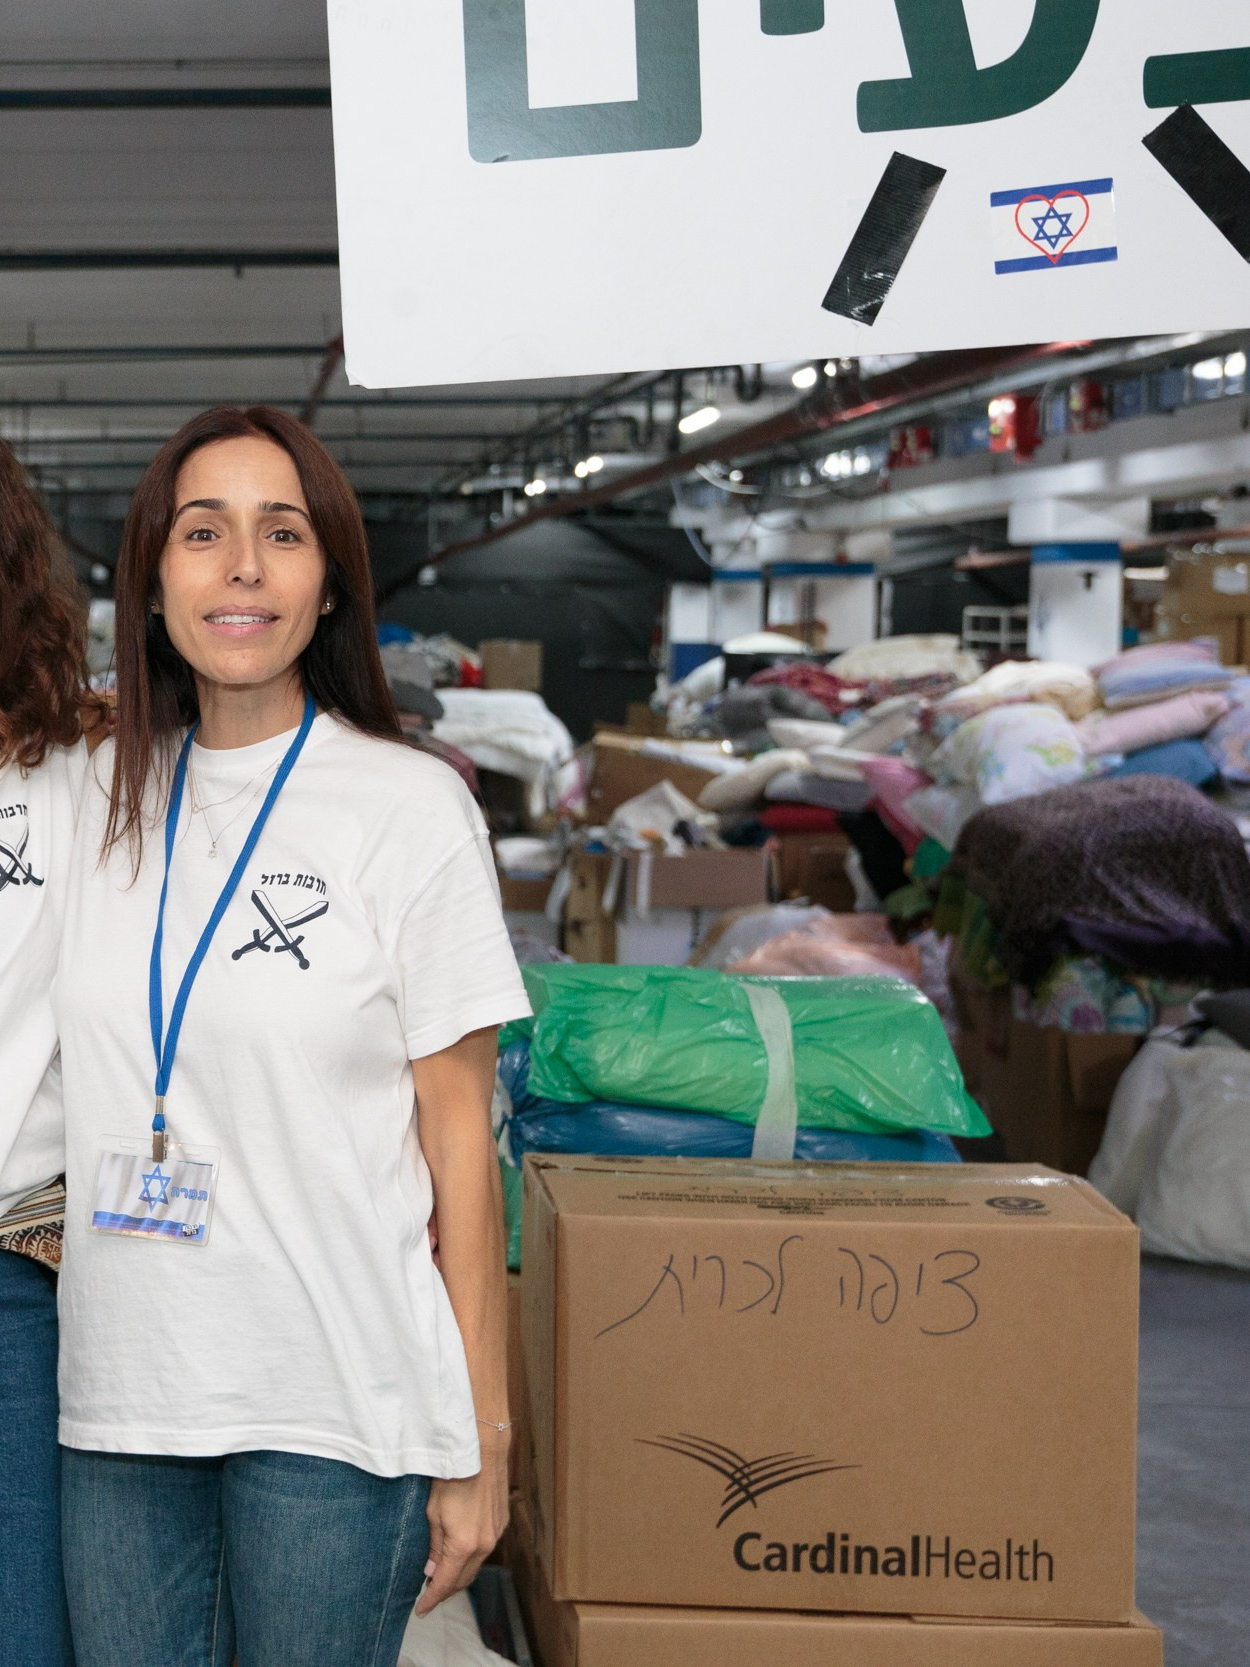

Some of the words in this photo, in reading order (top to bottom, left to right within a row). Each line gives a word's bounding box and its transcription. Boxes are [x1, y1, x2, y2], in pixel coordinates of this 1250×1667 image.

[261, 873, 291, 886] ברזל
[293, 873, 327, 895] חרבות
[733, 1531, 1055, 1583] CardinalHealth
